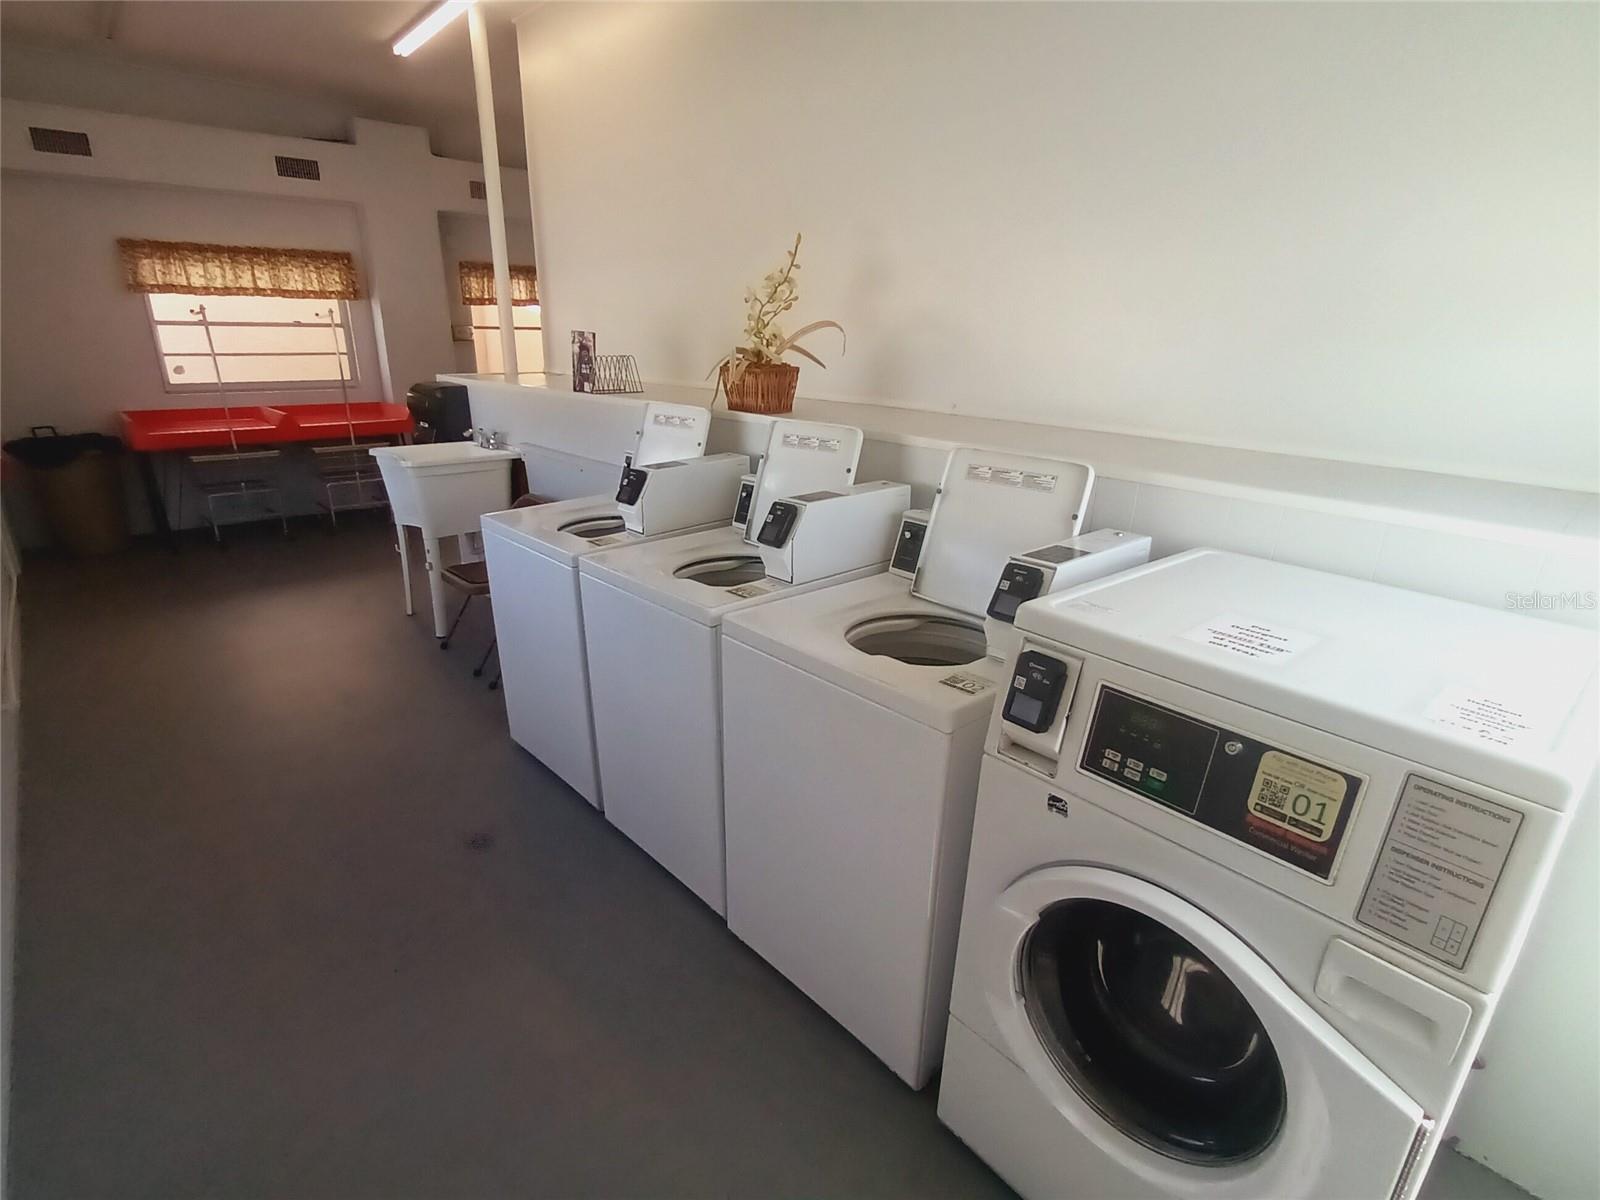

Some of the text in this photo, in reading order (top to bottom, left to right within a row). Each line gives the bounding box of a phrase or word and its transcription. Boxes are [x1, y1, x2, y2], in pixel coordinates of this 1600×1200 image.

[1291, 793, 1327, 826] 01
[1455, 795, 1512, 824] INSTRUCTIONS
[1430, 860, 1485, 889] INSTRUCTIONS
